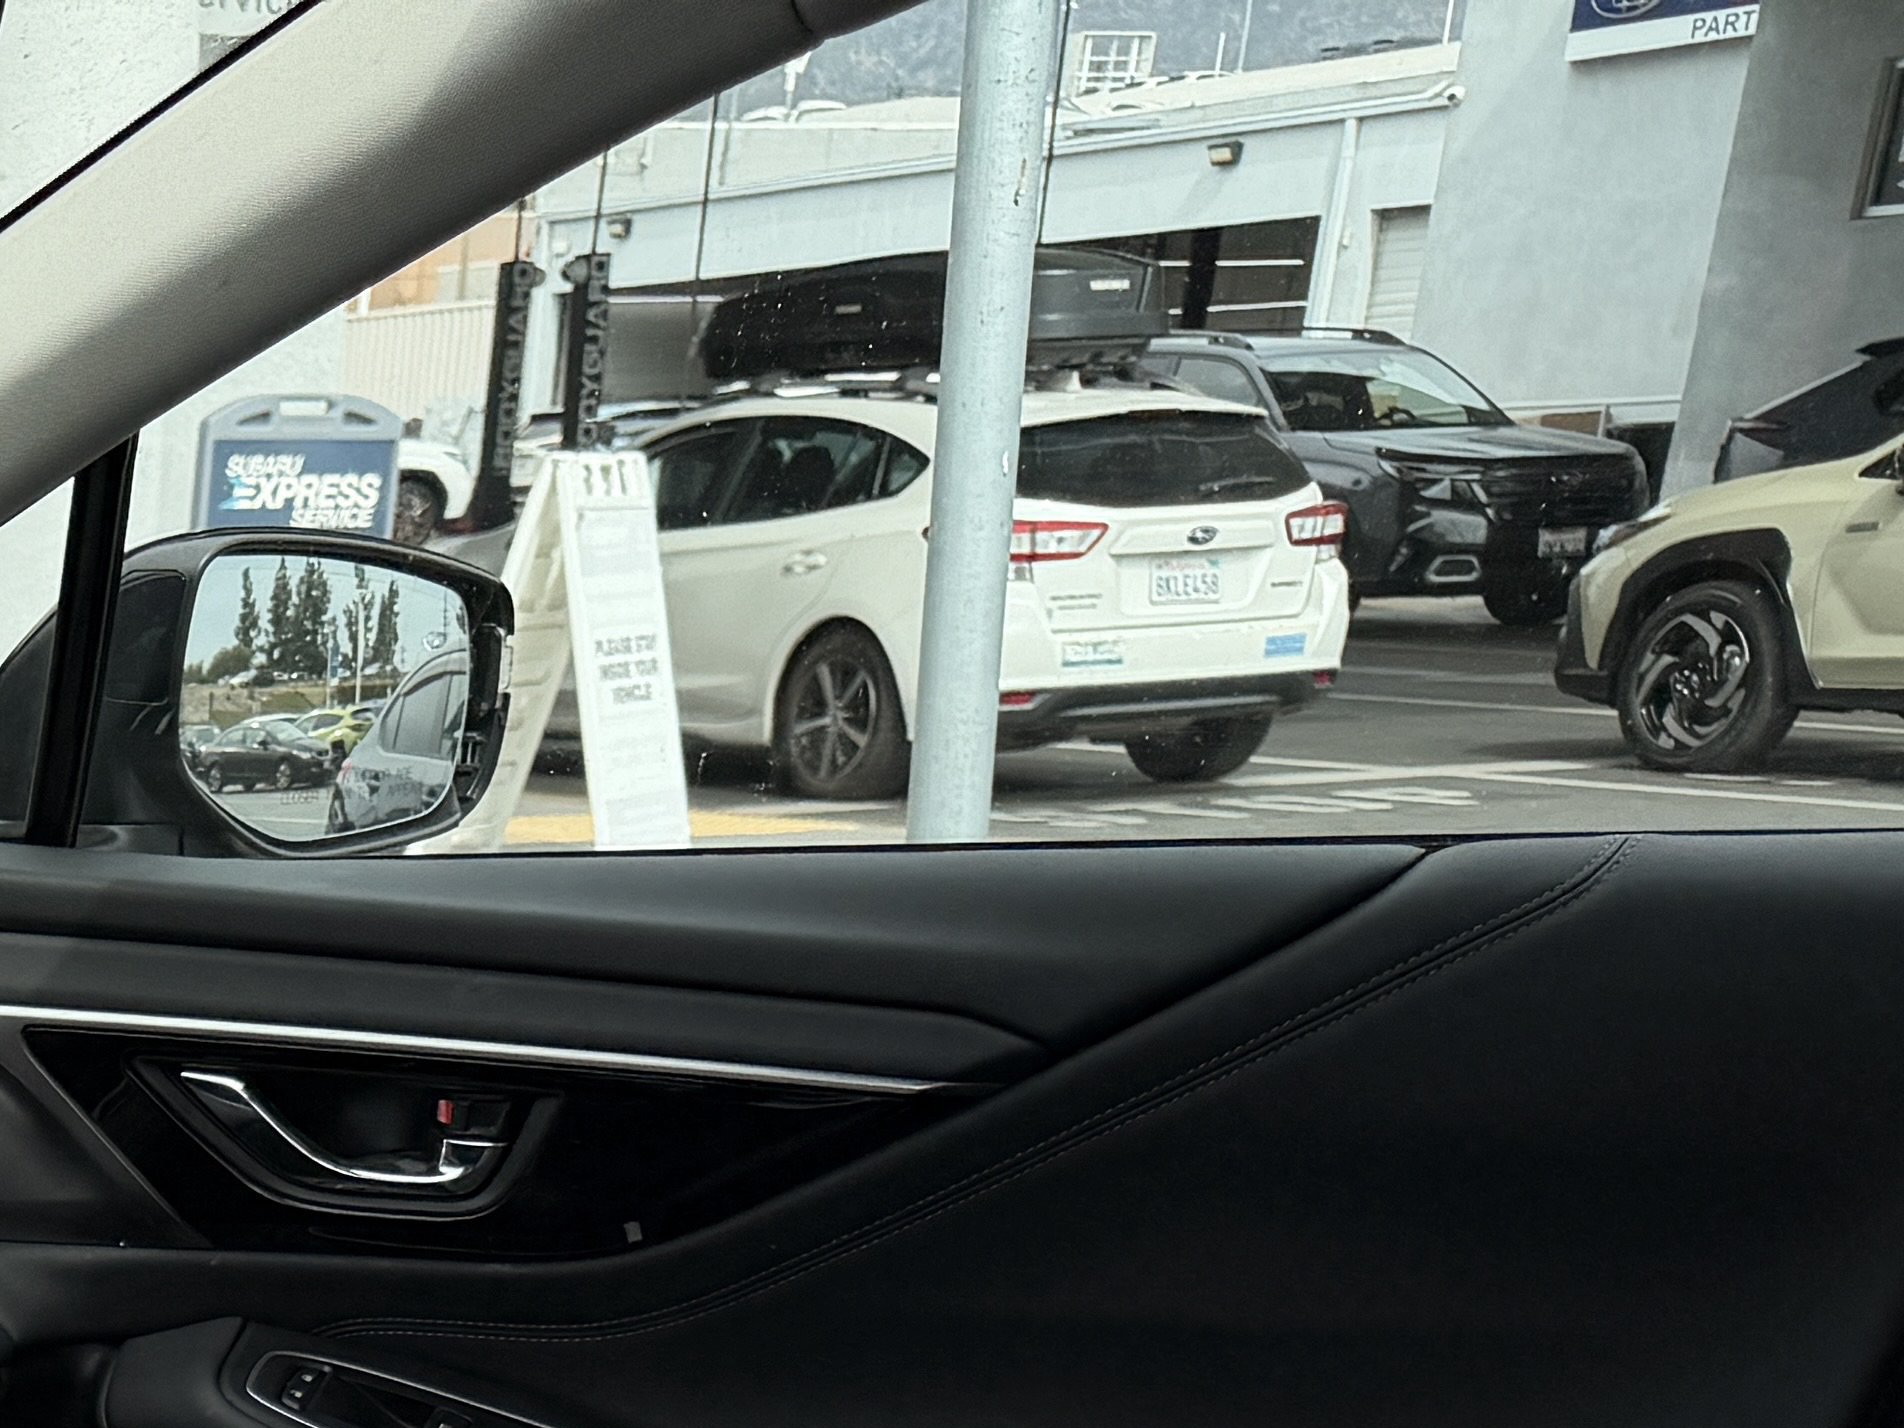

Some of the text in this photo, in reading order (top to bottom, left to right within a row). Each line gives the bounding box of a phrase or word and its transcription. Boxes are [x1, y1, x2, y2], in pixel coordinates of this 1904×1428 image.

[225, 453, 305, 478] SUBARU
[220, 473, 383, 510] EXPRESS
[289, 508, 376, 529] SERVICE
